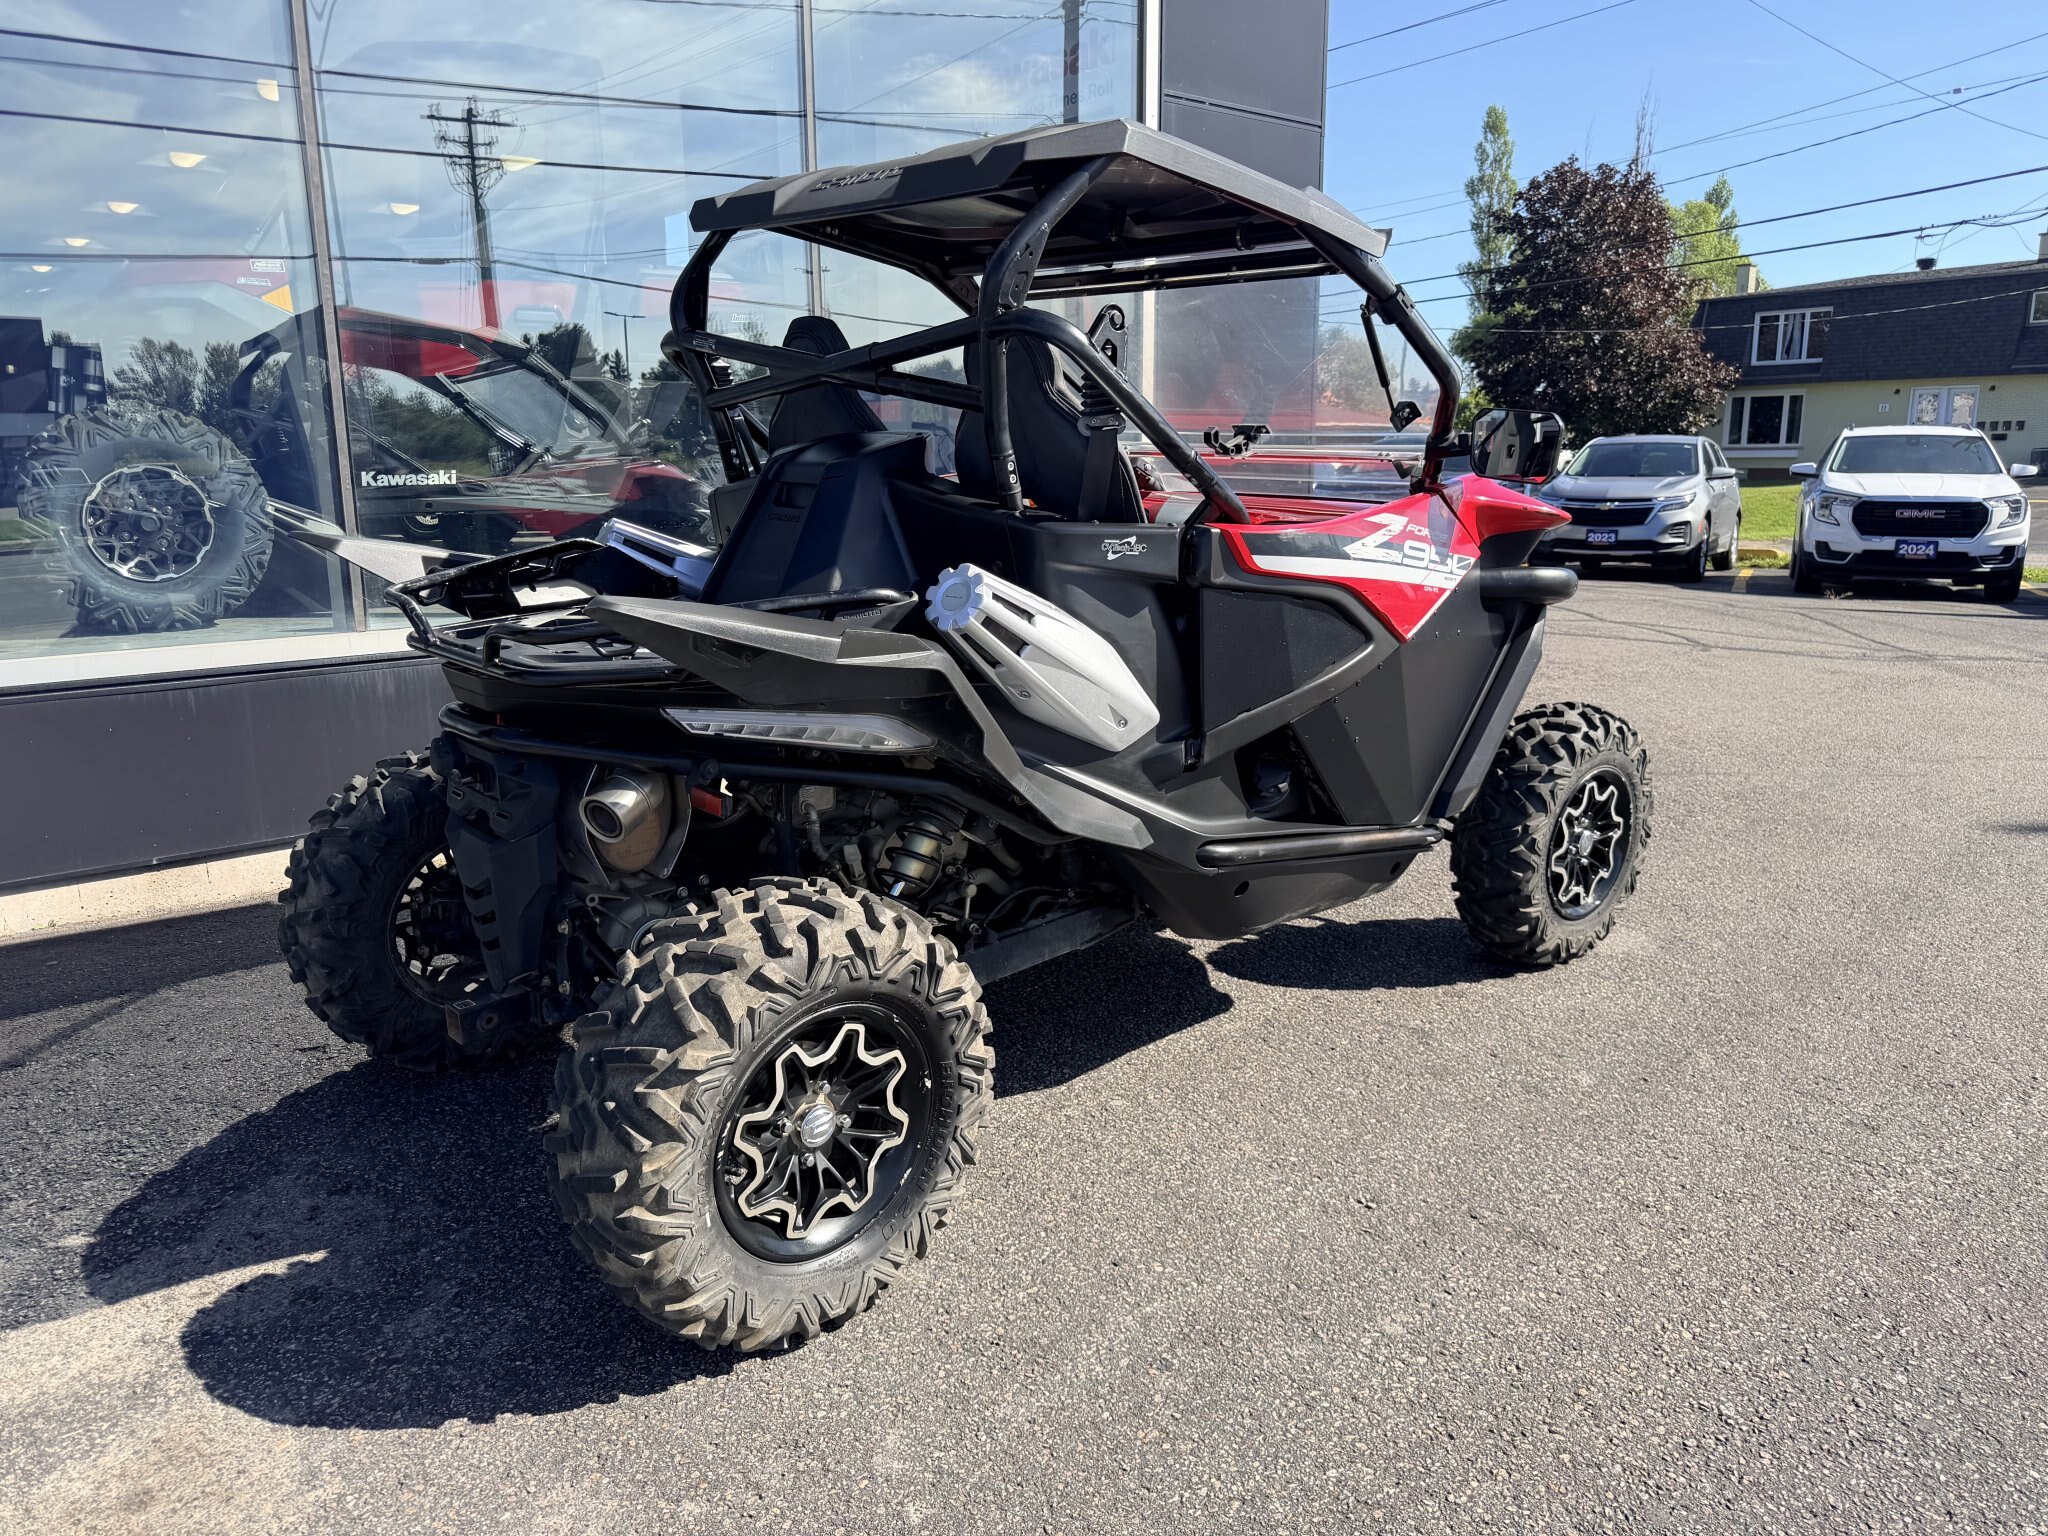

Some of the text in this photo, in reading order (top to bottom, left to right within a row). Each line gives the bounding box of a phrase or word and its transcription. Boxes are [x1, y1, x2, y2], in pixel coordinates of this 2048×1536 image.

[1088, 78, 1113, 100] Roll
[361, 470, 457, 487] Kawasaki
[1895, 508, 1946, 518] GMC
[1342, 512, 1448, 563] Z FORCE
[1587, 532, 1616, 542] 2023
[1402, 539, 1476, 577] 950
[1898, 543, 1935, 556] 2024
